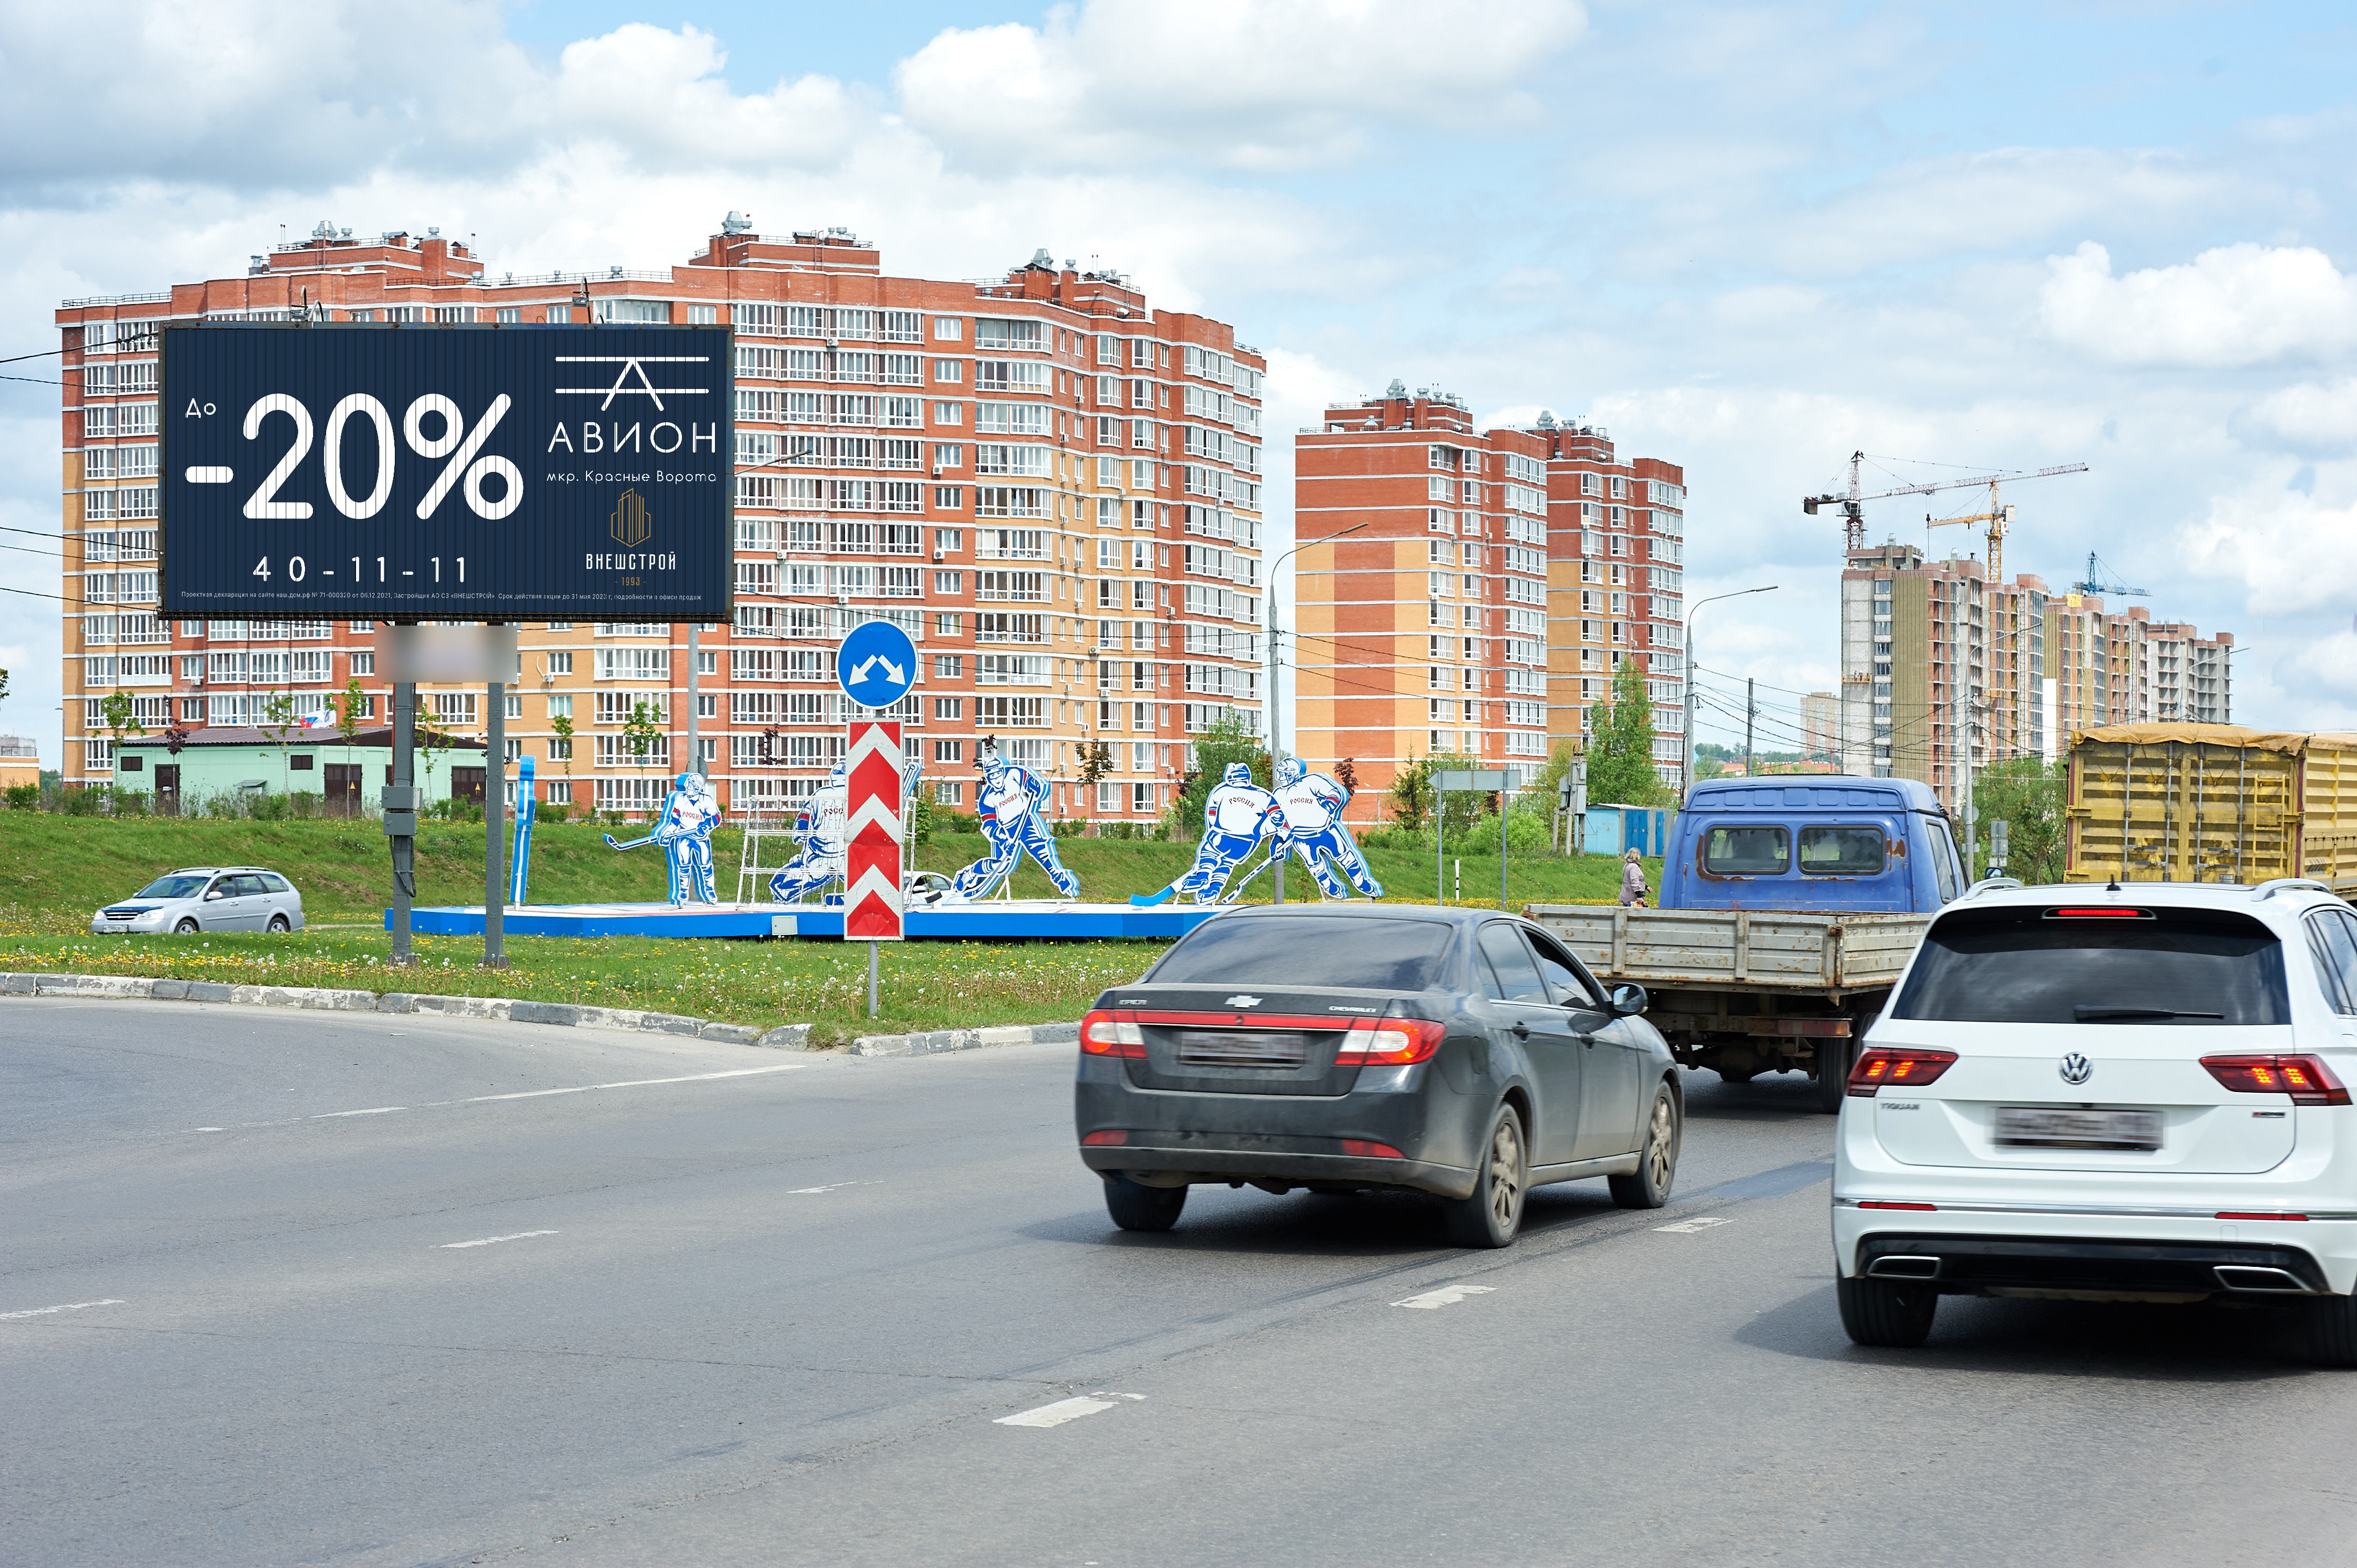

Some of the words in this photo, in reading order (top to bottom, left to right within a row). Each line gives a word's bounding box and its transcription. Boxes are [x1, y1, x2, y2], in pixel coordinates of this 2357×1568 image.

[185, 398, 217, 419] До
[548, 421, 716, 453] АВИОН
[186, 393, 523, 519] -20%
[547, 472, 579, 484] мкр.
[585, 470, 650, 484] Красные
[657, 470, 717, 484] Ворота
[586, 551, 676, 570] ВНЕШСТРОЙ
[999, 793, 1018, 808] РОССИЯ
[1229, 797, 1255, 808] РОССИЯ
[682, 811, 703, 821] РОССИЯ
